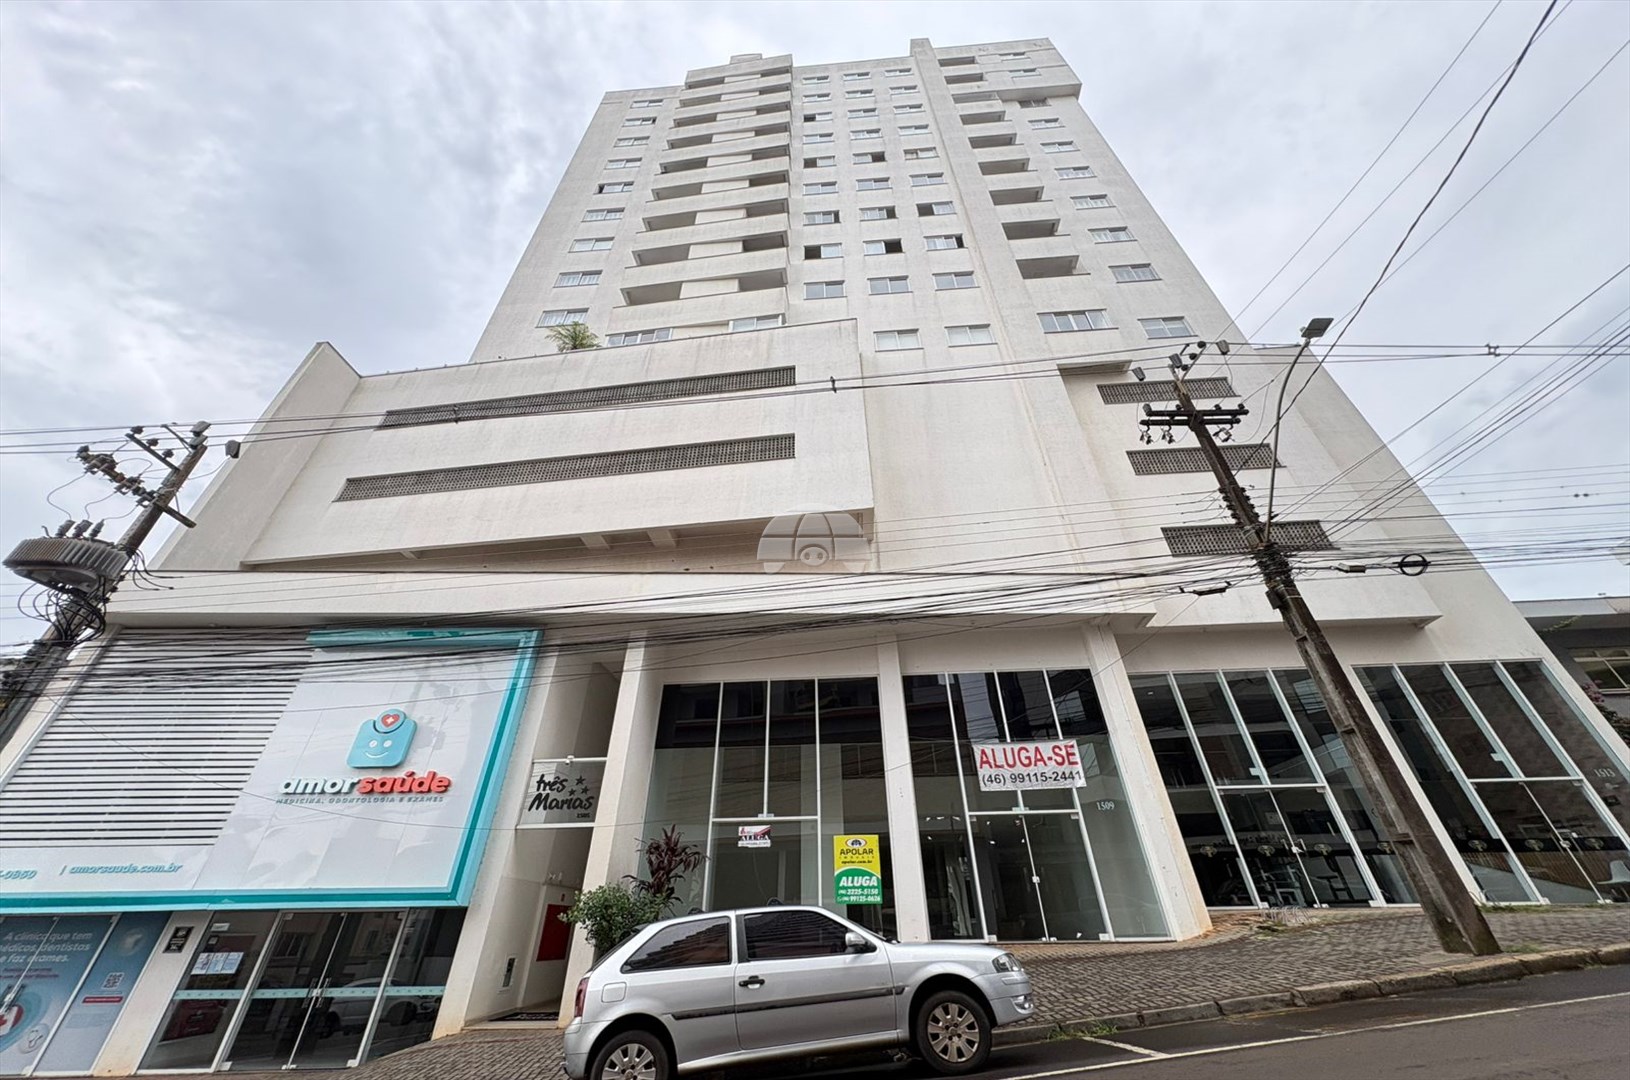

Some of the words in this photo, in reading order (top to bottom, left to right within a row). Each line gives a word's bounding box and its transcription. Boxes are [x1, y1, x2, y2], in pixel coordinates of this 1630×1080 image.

[979, 743, 1079, 769] ALUGA-SE
[278, 771, 453, 795] amorsaúde
[536, 773, 569, 793] três
[982, 773, 1007, 787] (46)
[1009, 770, 1083, 784] 99115-2441
[275, 797, 325, 806] MEDICINA,
[328, 796, 396, 805] ODONTOLOGIA
[407, 795, 445, 804] EXAMES
[527, 792, 595, 812] Marias
[1096, 801, 1115, 811] 1509
[840, 848, 874, 856] APOLAR
[69, 862, 183, 875] amorsaude.com.br
[839, 875, 878, 887] ALUGA
[5, 932, 13, 941] A
[49, 932, 70, 943] que
[72, 932, 93, 940] tem
